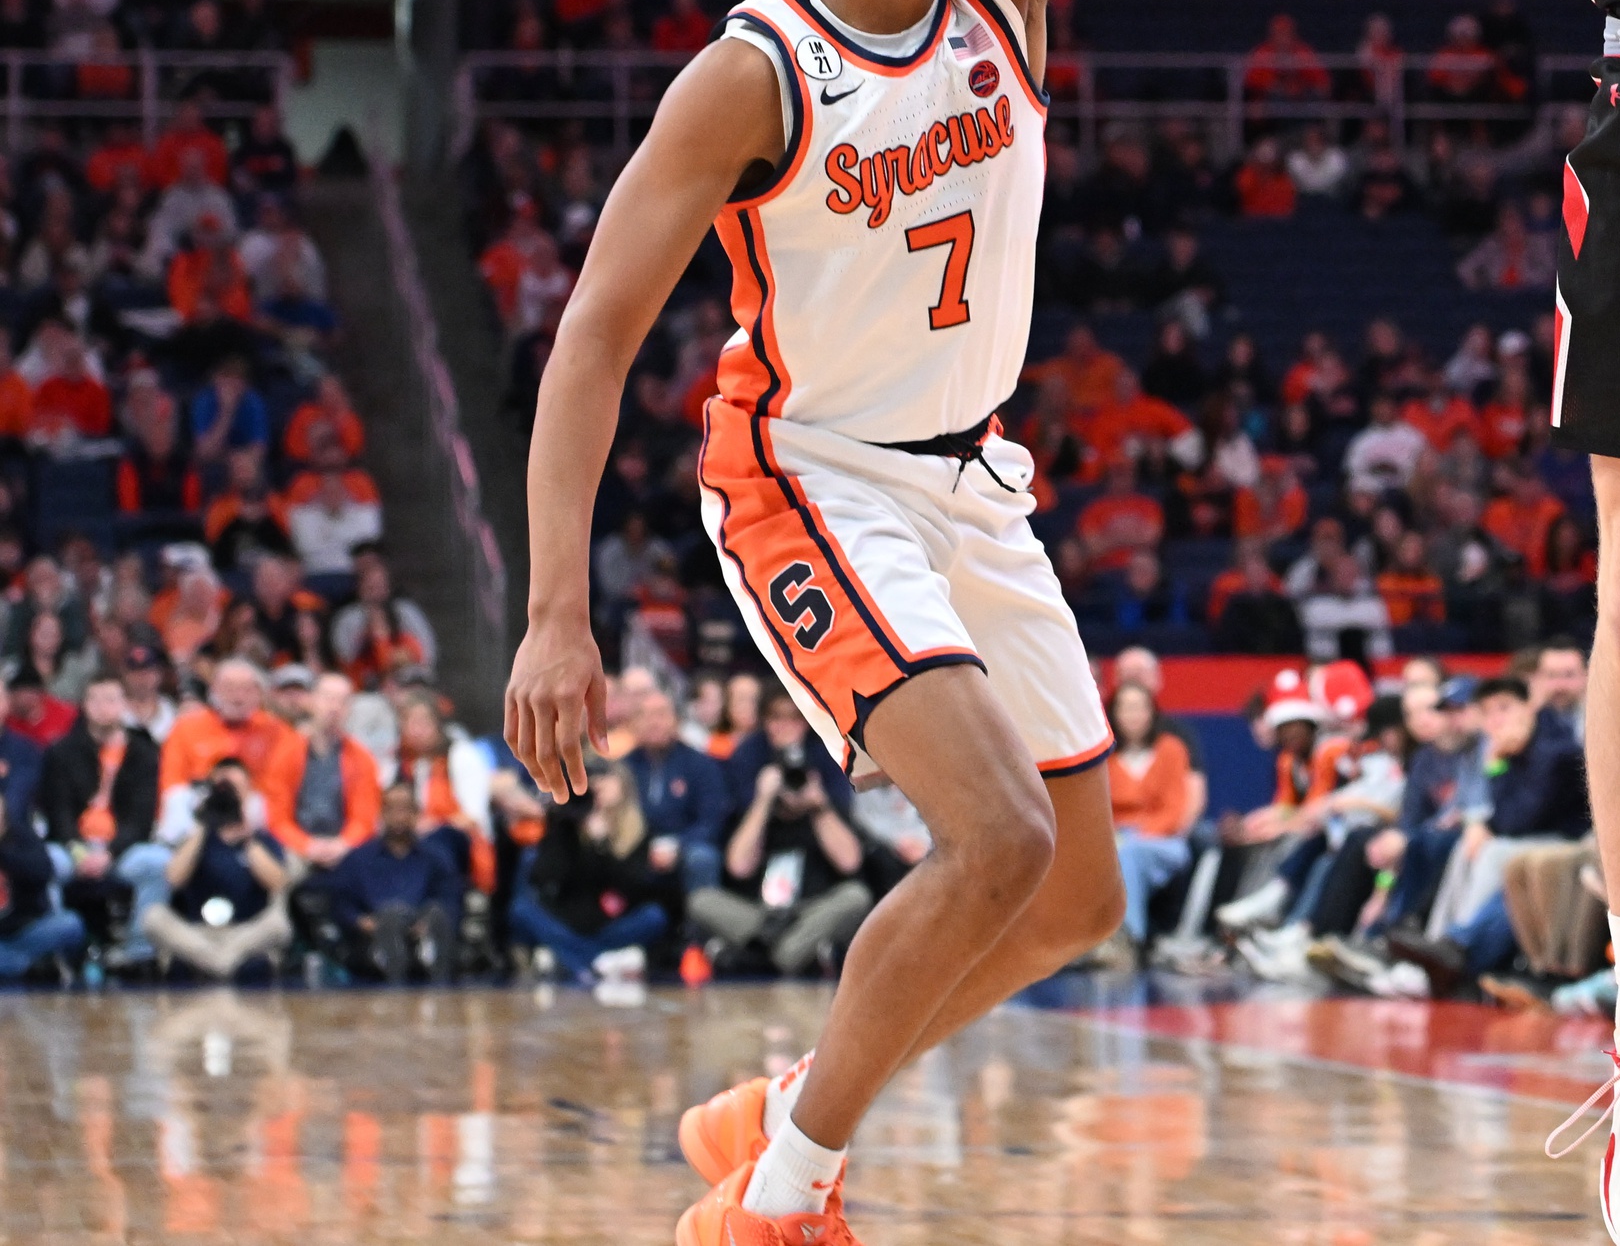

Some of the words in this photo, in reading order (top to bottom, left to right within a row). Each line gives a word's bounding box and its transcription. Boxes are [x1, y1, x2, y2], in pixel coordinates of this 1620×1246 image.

[808, 41, 825, 54] LM
[814, 56, 832, 74] 21
[825, 94, 1014, 229] Syracuse
[905, 209, 975, 331] 7
[768, 560, 835, 652] S
